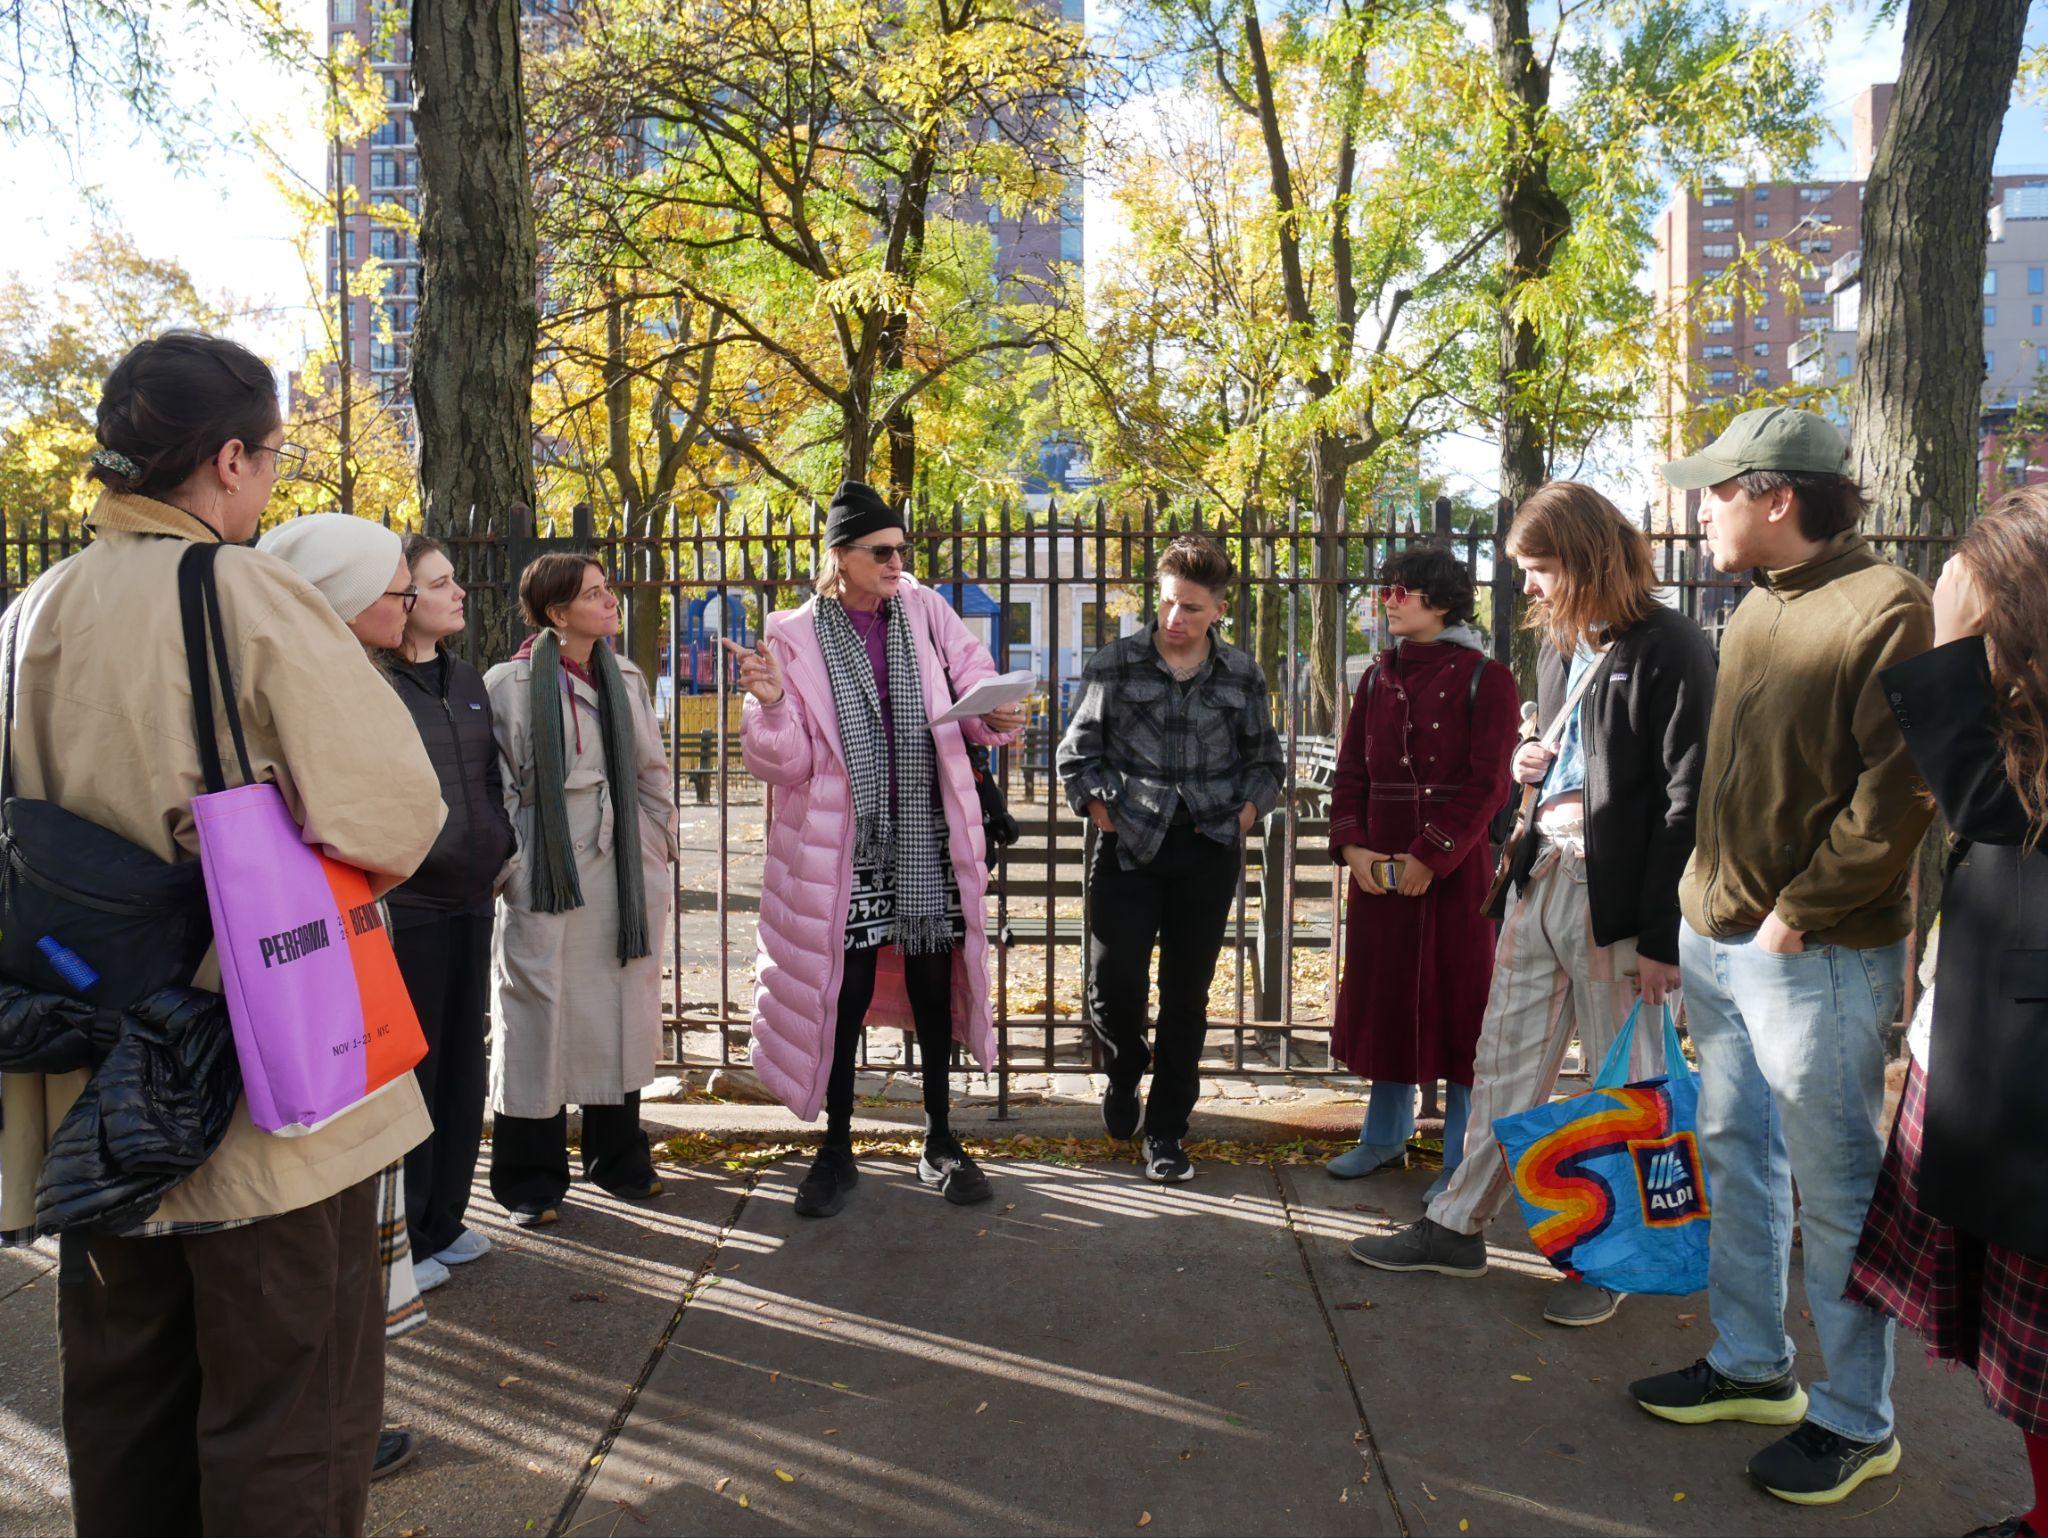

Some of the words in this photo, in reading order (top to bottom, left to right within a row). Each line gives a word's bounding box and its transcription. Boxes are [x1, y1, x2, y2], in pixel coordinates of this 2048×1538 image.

[259, 918, 330, 969] PERFORMA
[332, 1041, 349, 1056] NOV
[353, 1033, 371, 1048] 1-23
[377, 1024, 389, 1038] NYC
[1651, 1185, 1693, 1209] ALDI
